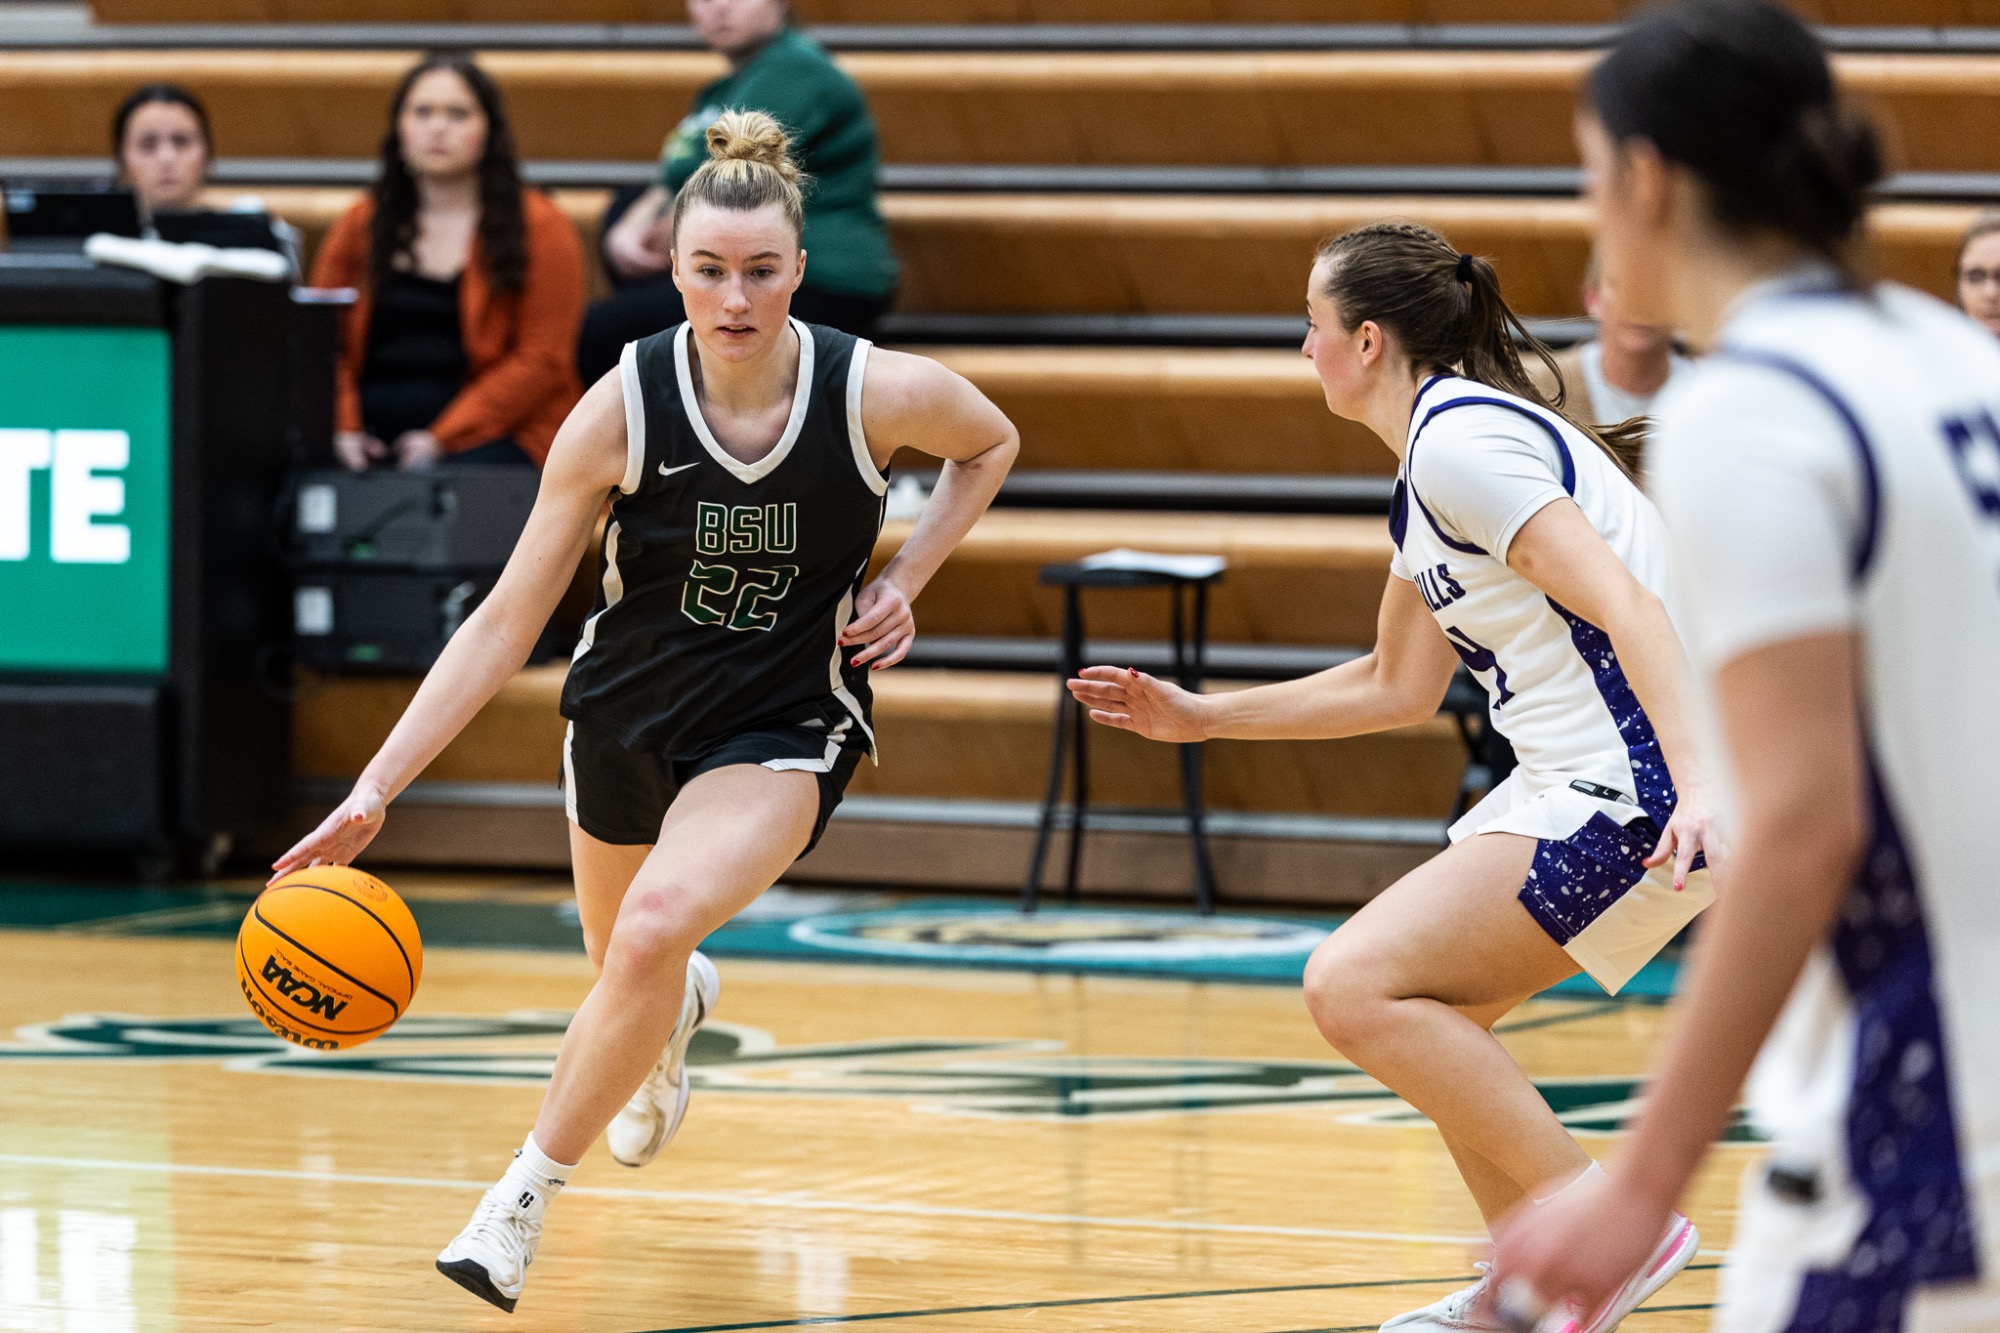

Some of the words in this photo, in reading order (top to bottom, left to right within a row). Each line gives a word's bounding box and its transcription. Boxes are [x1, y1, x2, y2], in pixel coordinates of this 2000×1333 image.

[696, 501, 797, 556] BSU
[681, 559, 800, 631] 22
[275, 947, 293, 967] BALL
[292, 964, 316, 983] GAME
[261, 954, 348, 1021] NCAA
[318, 981, 353, 1000] OFFICIAL
